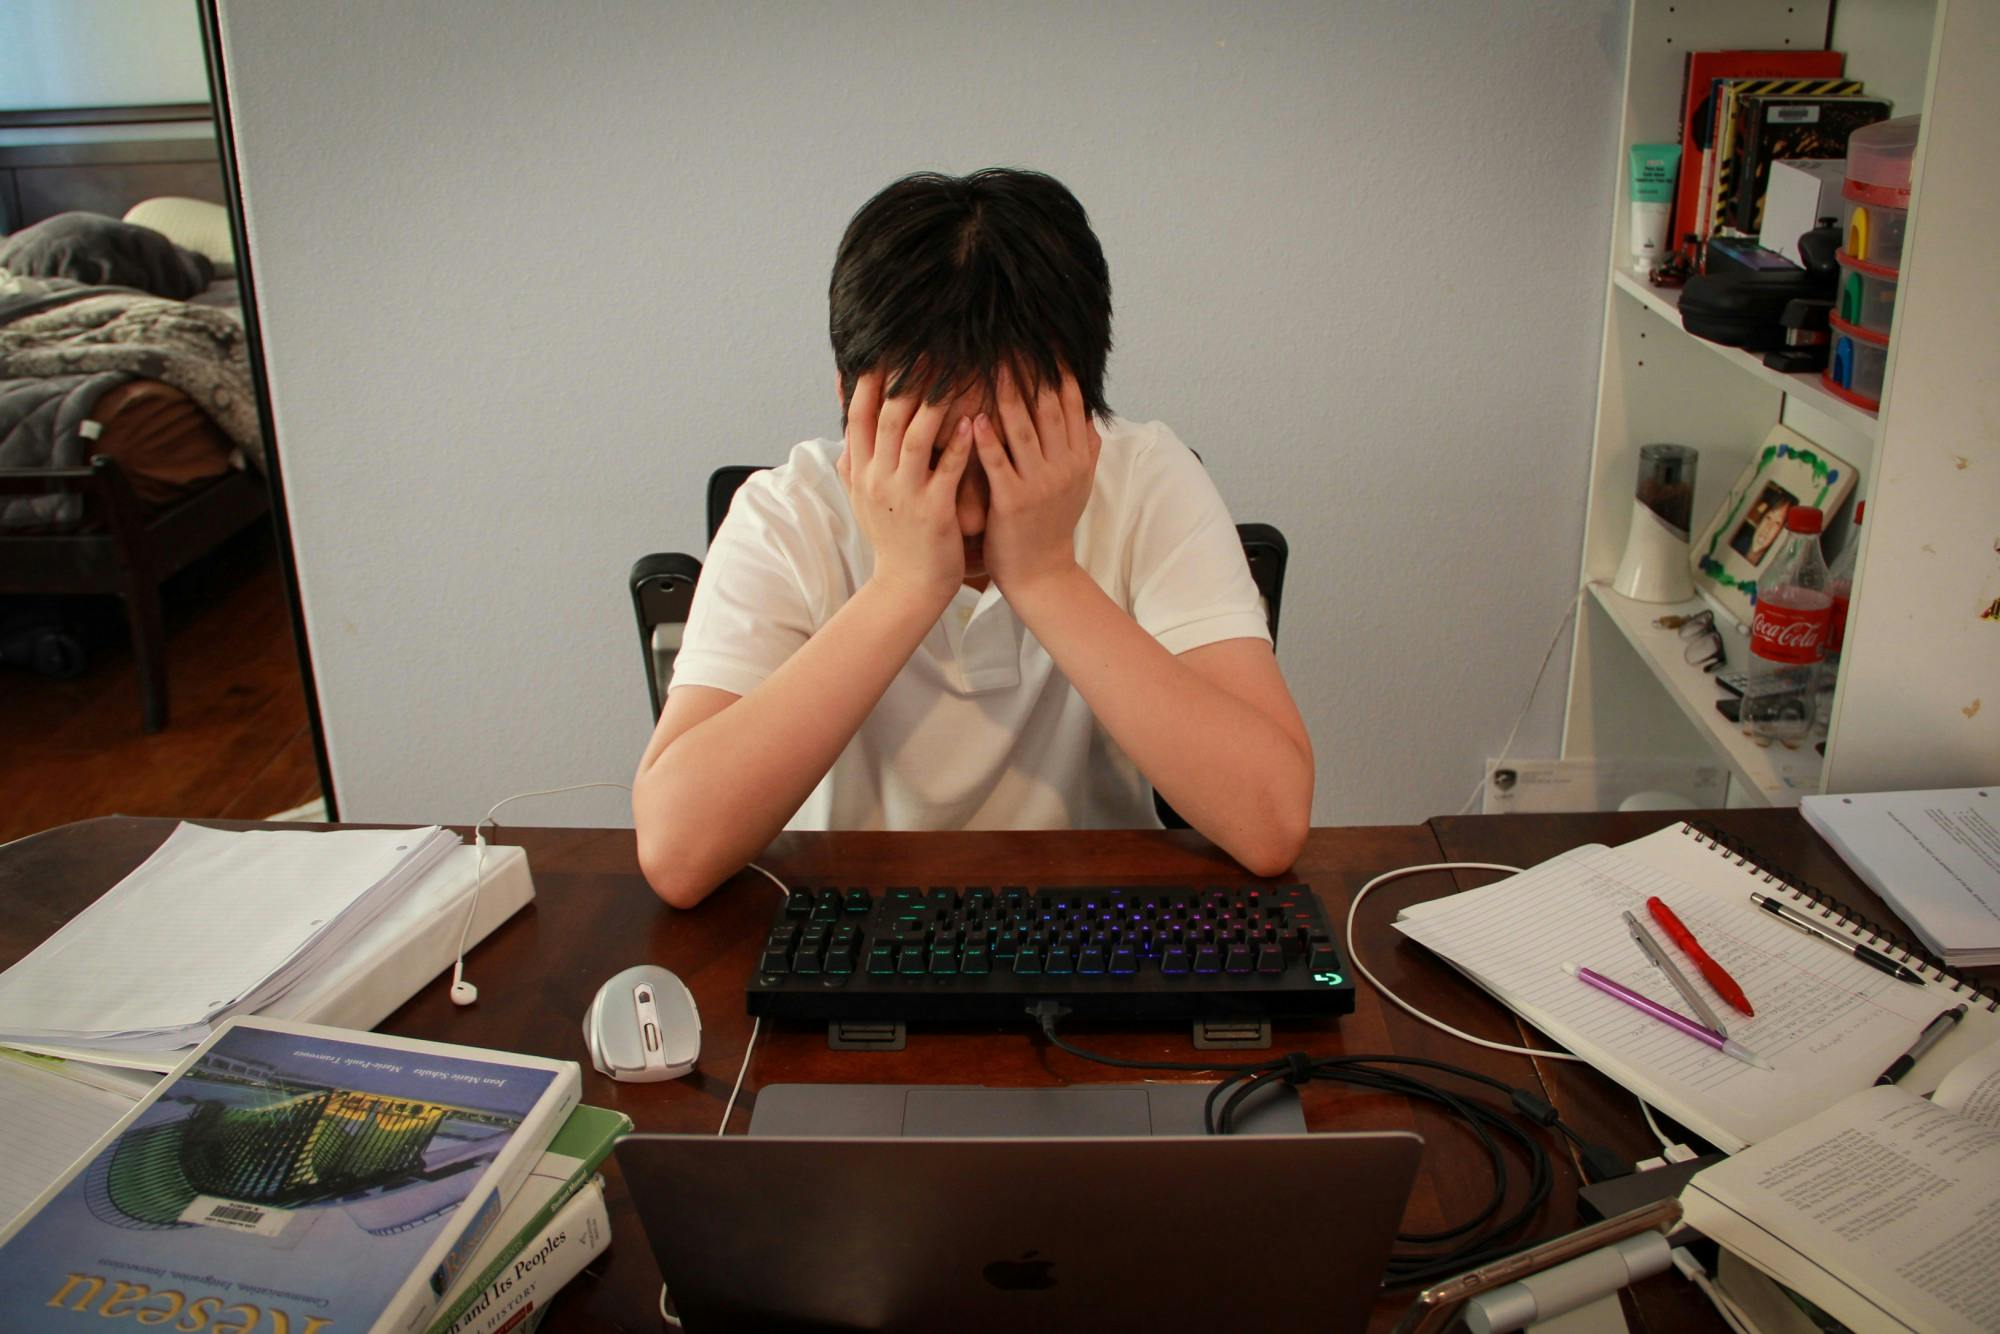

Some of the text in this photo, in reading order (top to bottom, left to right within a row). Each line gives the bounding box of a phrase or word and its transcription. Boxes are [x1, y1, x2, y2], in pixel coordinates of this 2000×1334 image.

[1752, 612, 1821, 648] Coca-Cola
[344, 1057, 403, 1073] Marie-Paule
[451, 1072, 480, 1085] Marie
[483, 1077, 509, 1088] Jean
[463, 1291, 490, 1325] and
[492, 1278, 513, 1299] Its
[513, 1231, 567, 1280] Peoples
[487, 1280, 537, 1329] HISTORY
